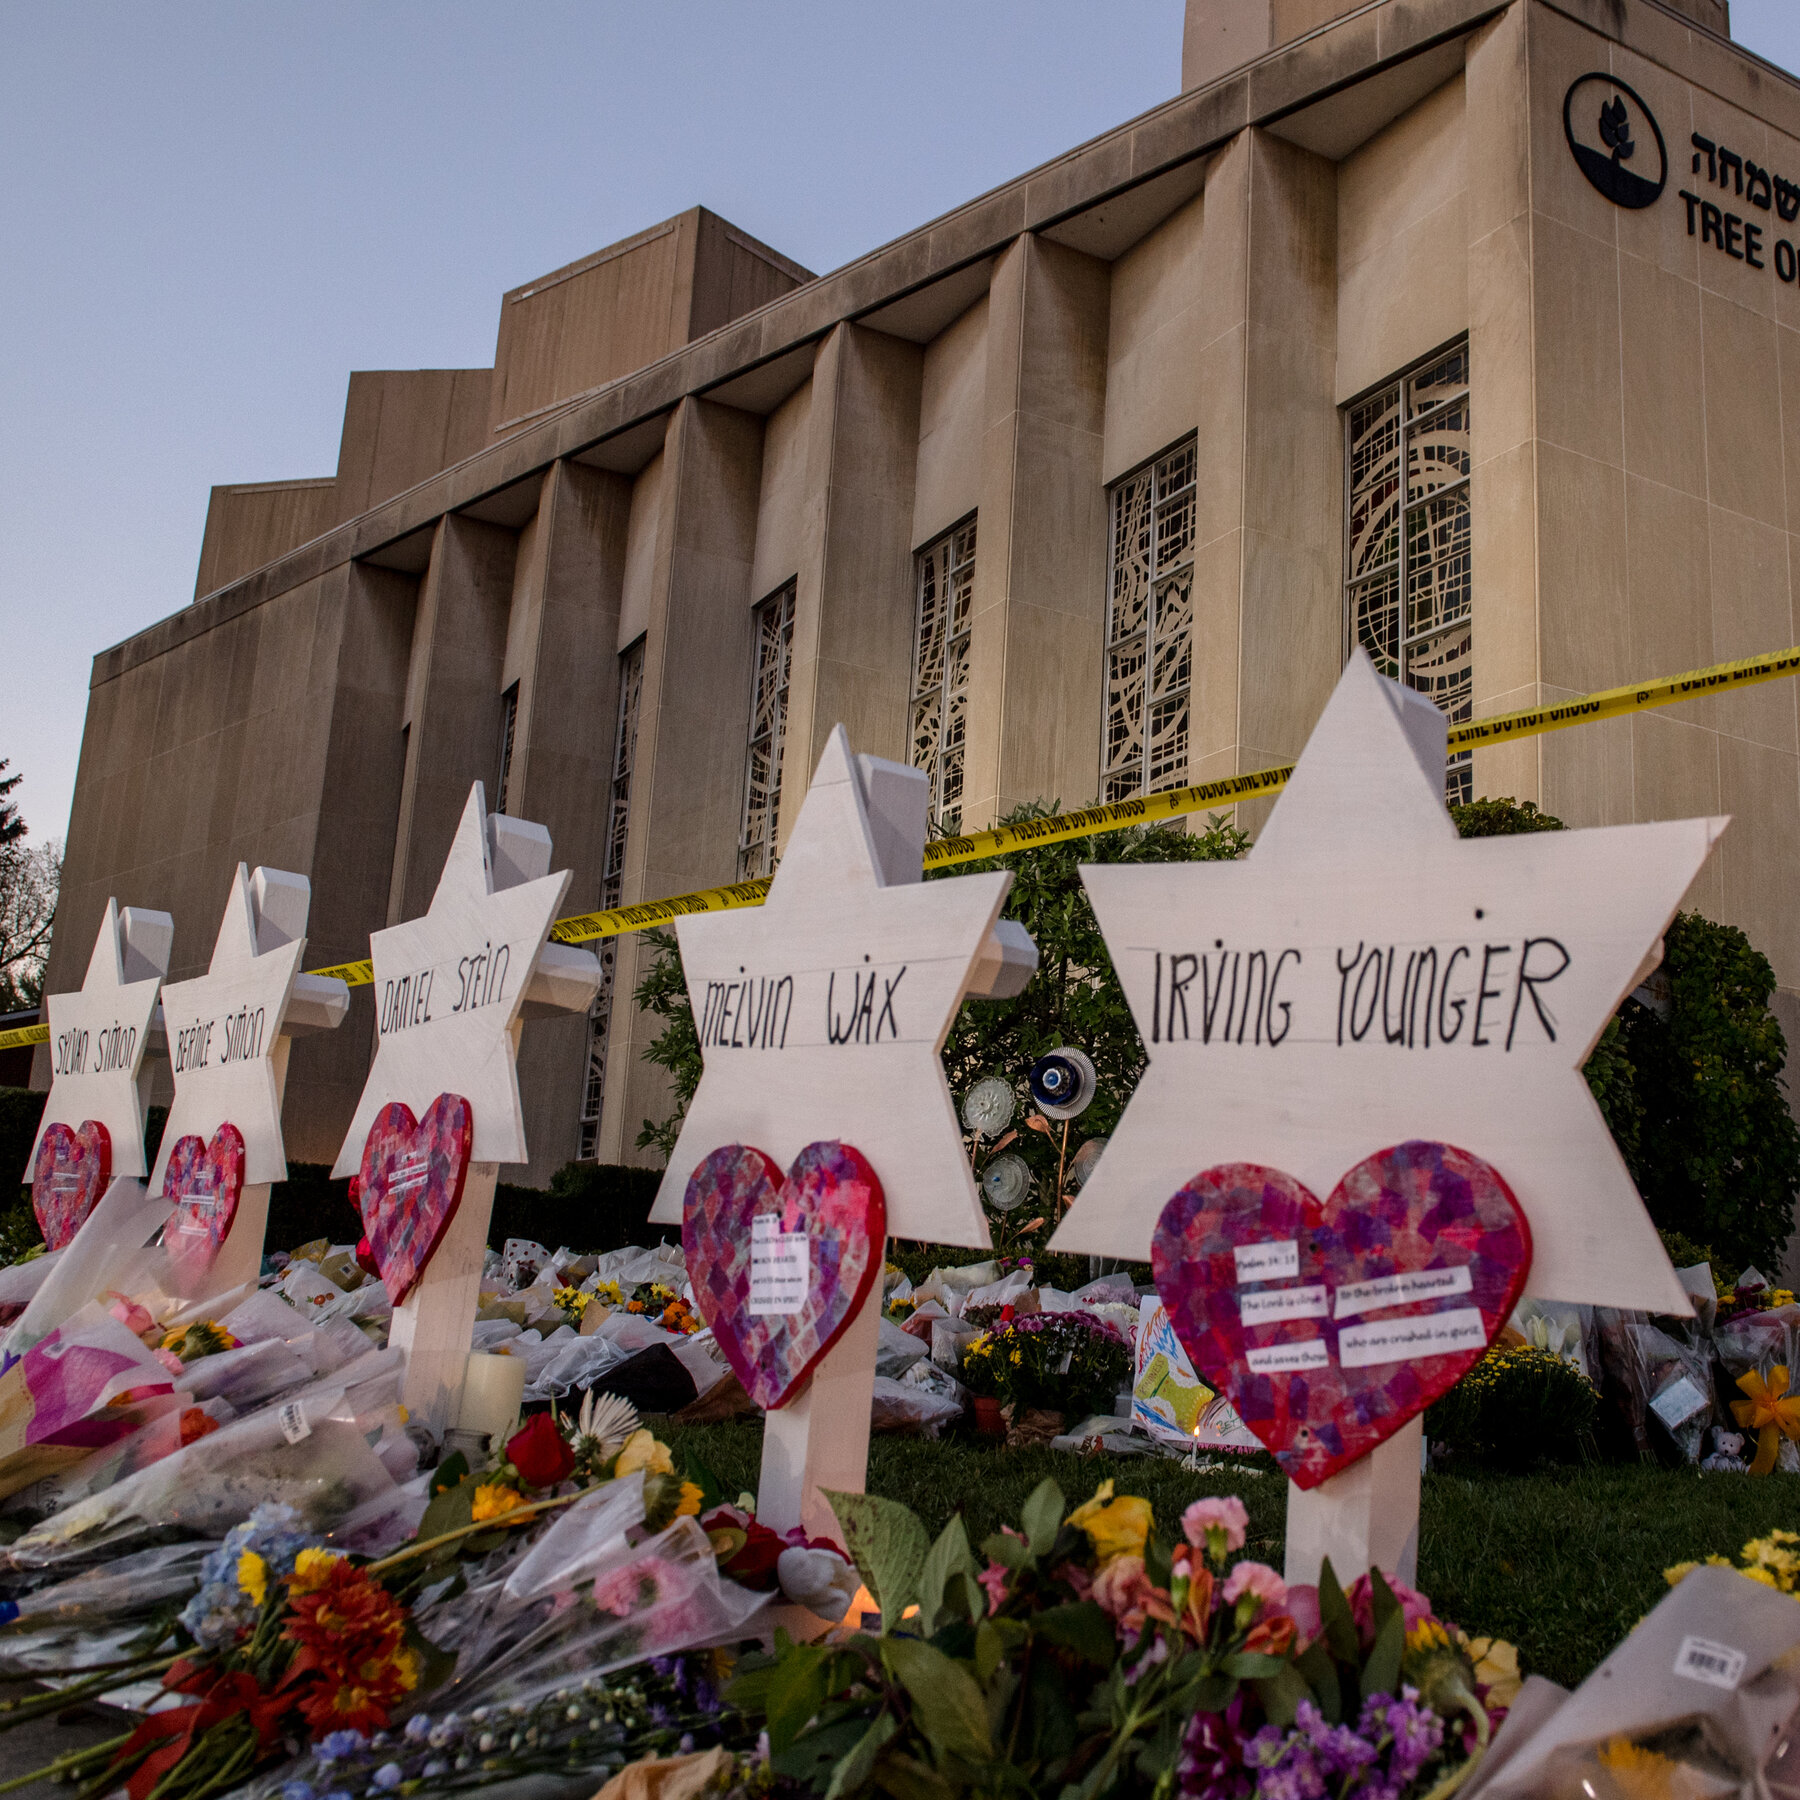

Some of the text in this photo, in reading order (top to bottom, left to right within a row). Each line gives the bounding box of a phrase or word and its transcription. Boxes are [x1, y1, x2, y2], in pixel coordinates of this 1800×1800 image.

[1679, 189, 1800, 289] TREE O
[1010, 821, 1047, 842] POLICE
[1045, 815, 1070, 835] LINE
[1068, 809, 1086, 829] DO
[1085, 805, 1108, 826] NOT
[827, 954, 907, 1046] WAX
[1336, 936, 1571, 1051] YOUNGER
